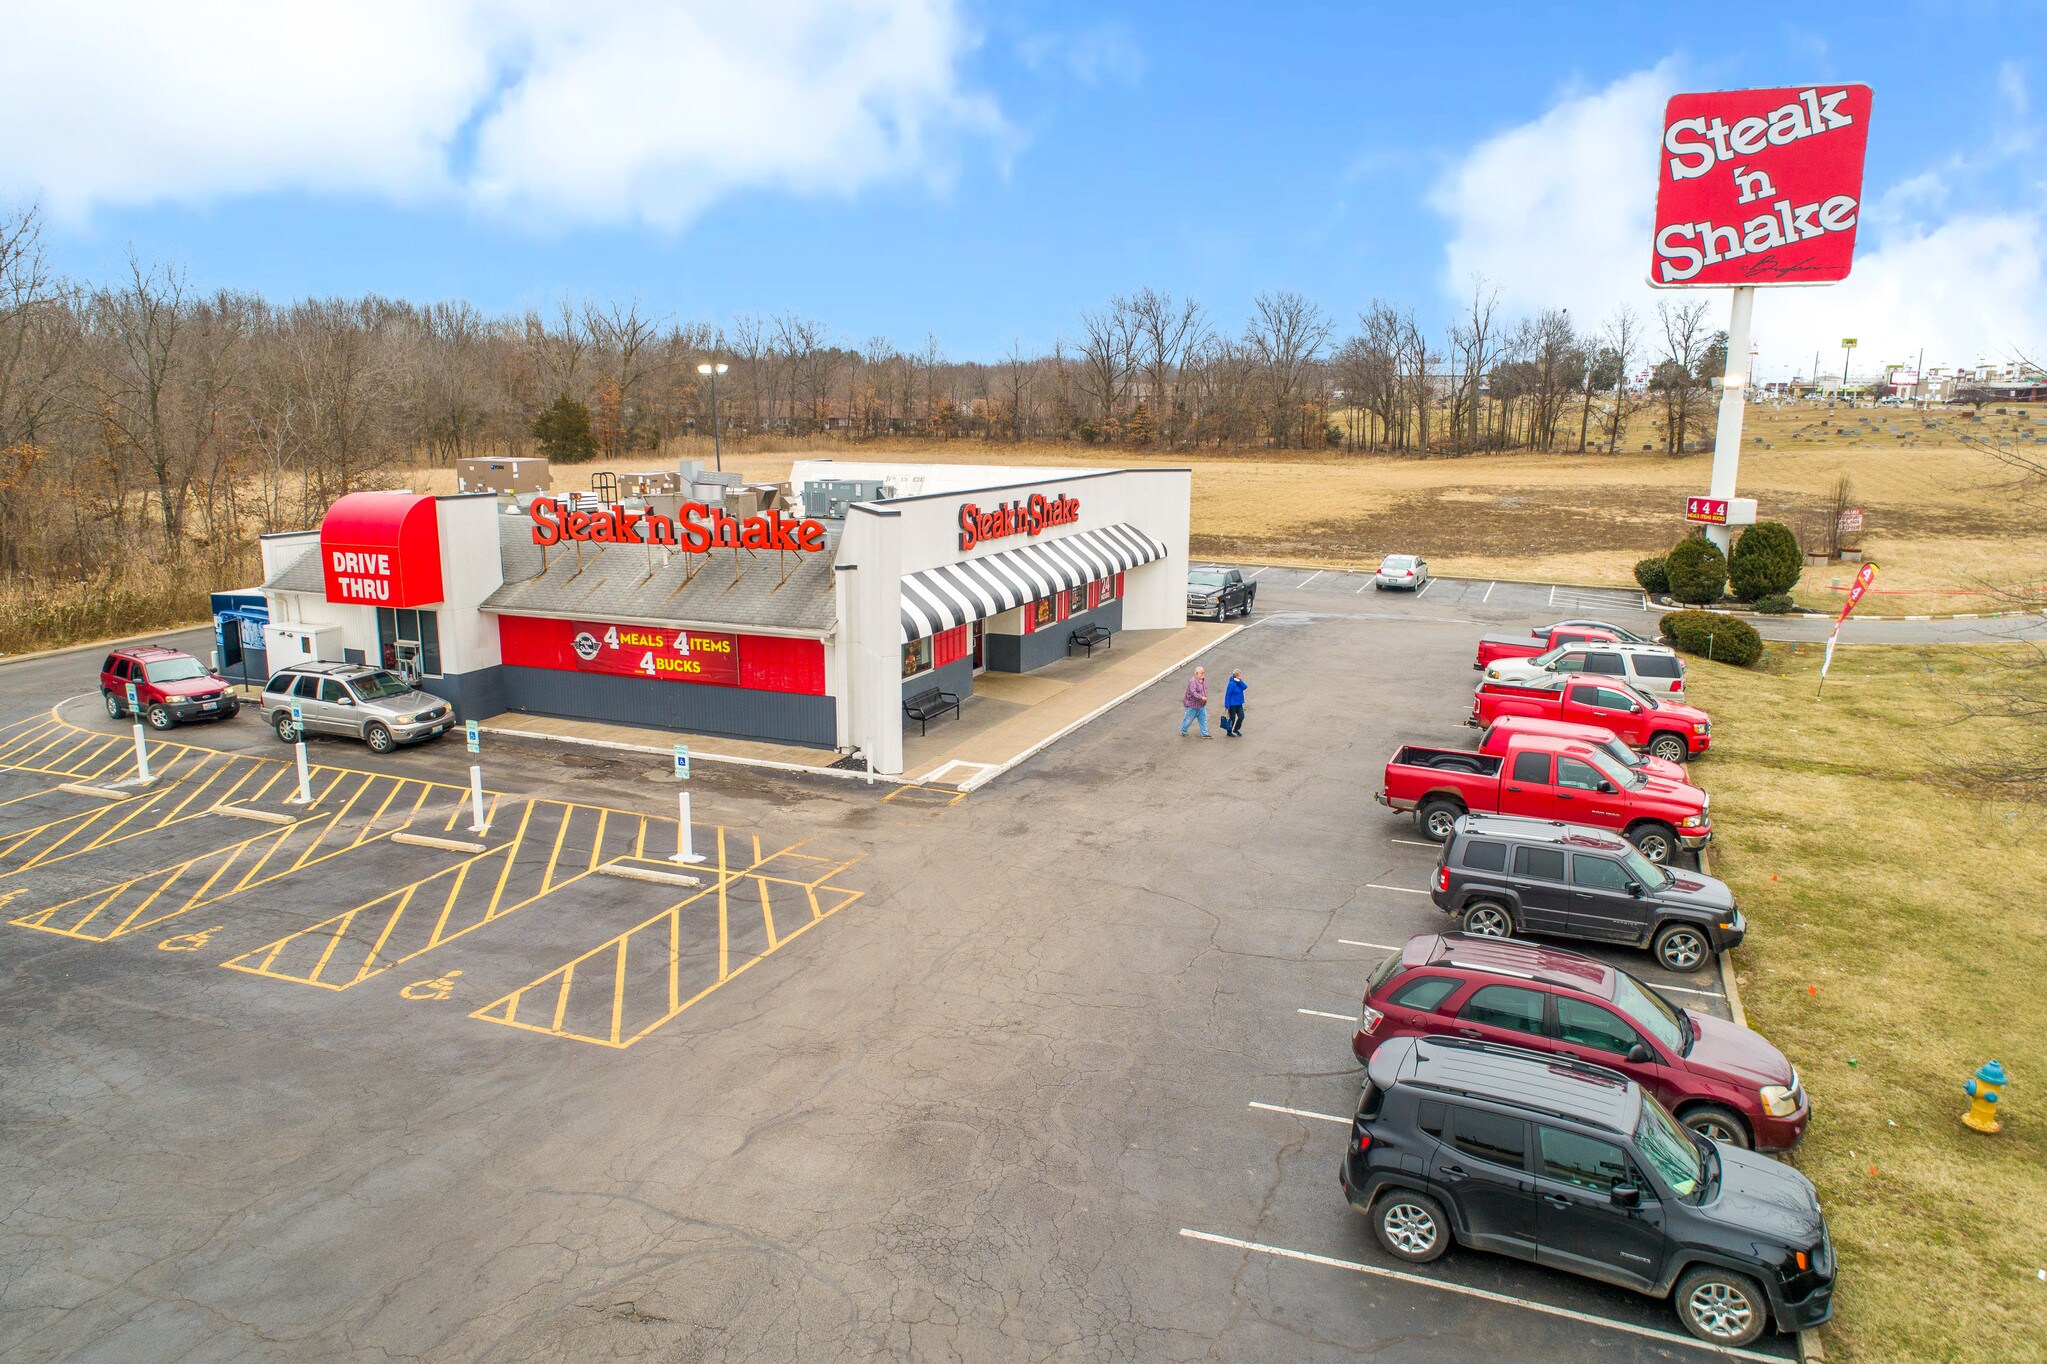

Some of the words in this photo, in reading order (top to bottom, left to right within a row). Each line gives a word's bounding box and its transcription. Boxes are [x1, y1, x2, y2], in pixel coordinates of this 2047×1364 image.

[1664, 87, 1854, 181] Steak
[1732, 164, 1777, 205] 'n
[1655, 194, 1859, 283] Shake
[1027, 493, 1080, 536] Shake
[1690, 500, 1698, 513] 4
[1702, 502, 1710, 514] 4
[1716, 503, 1725, 516] 4
[679, 502, 827, 554] Shake
[332, 551, 391, 576] DRIVE
[1862, 568, 1872, 582] 4
[338, 577, 390, 601] THRU
[1851, 587, 1862, 600] 4
[603, 626, 620, 650] 4
[620, 632, 664, 648] MEALS
[673, 631, 690, 656] 4
[690, 637, 731, 653] ITEMS
[639, 651, 656, 675] 4
[655, 657, 701, 674] BUCKS
